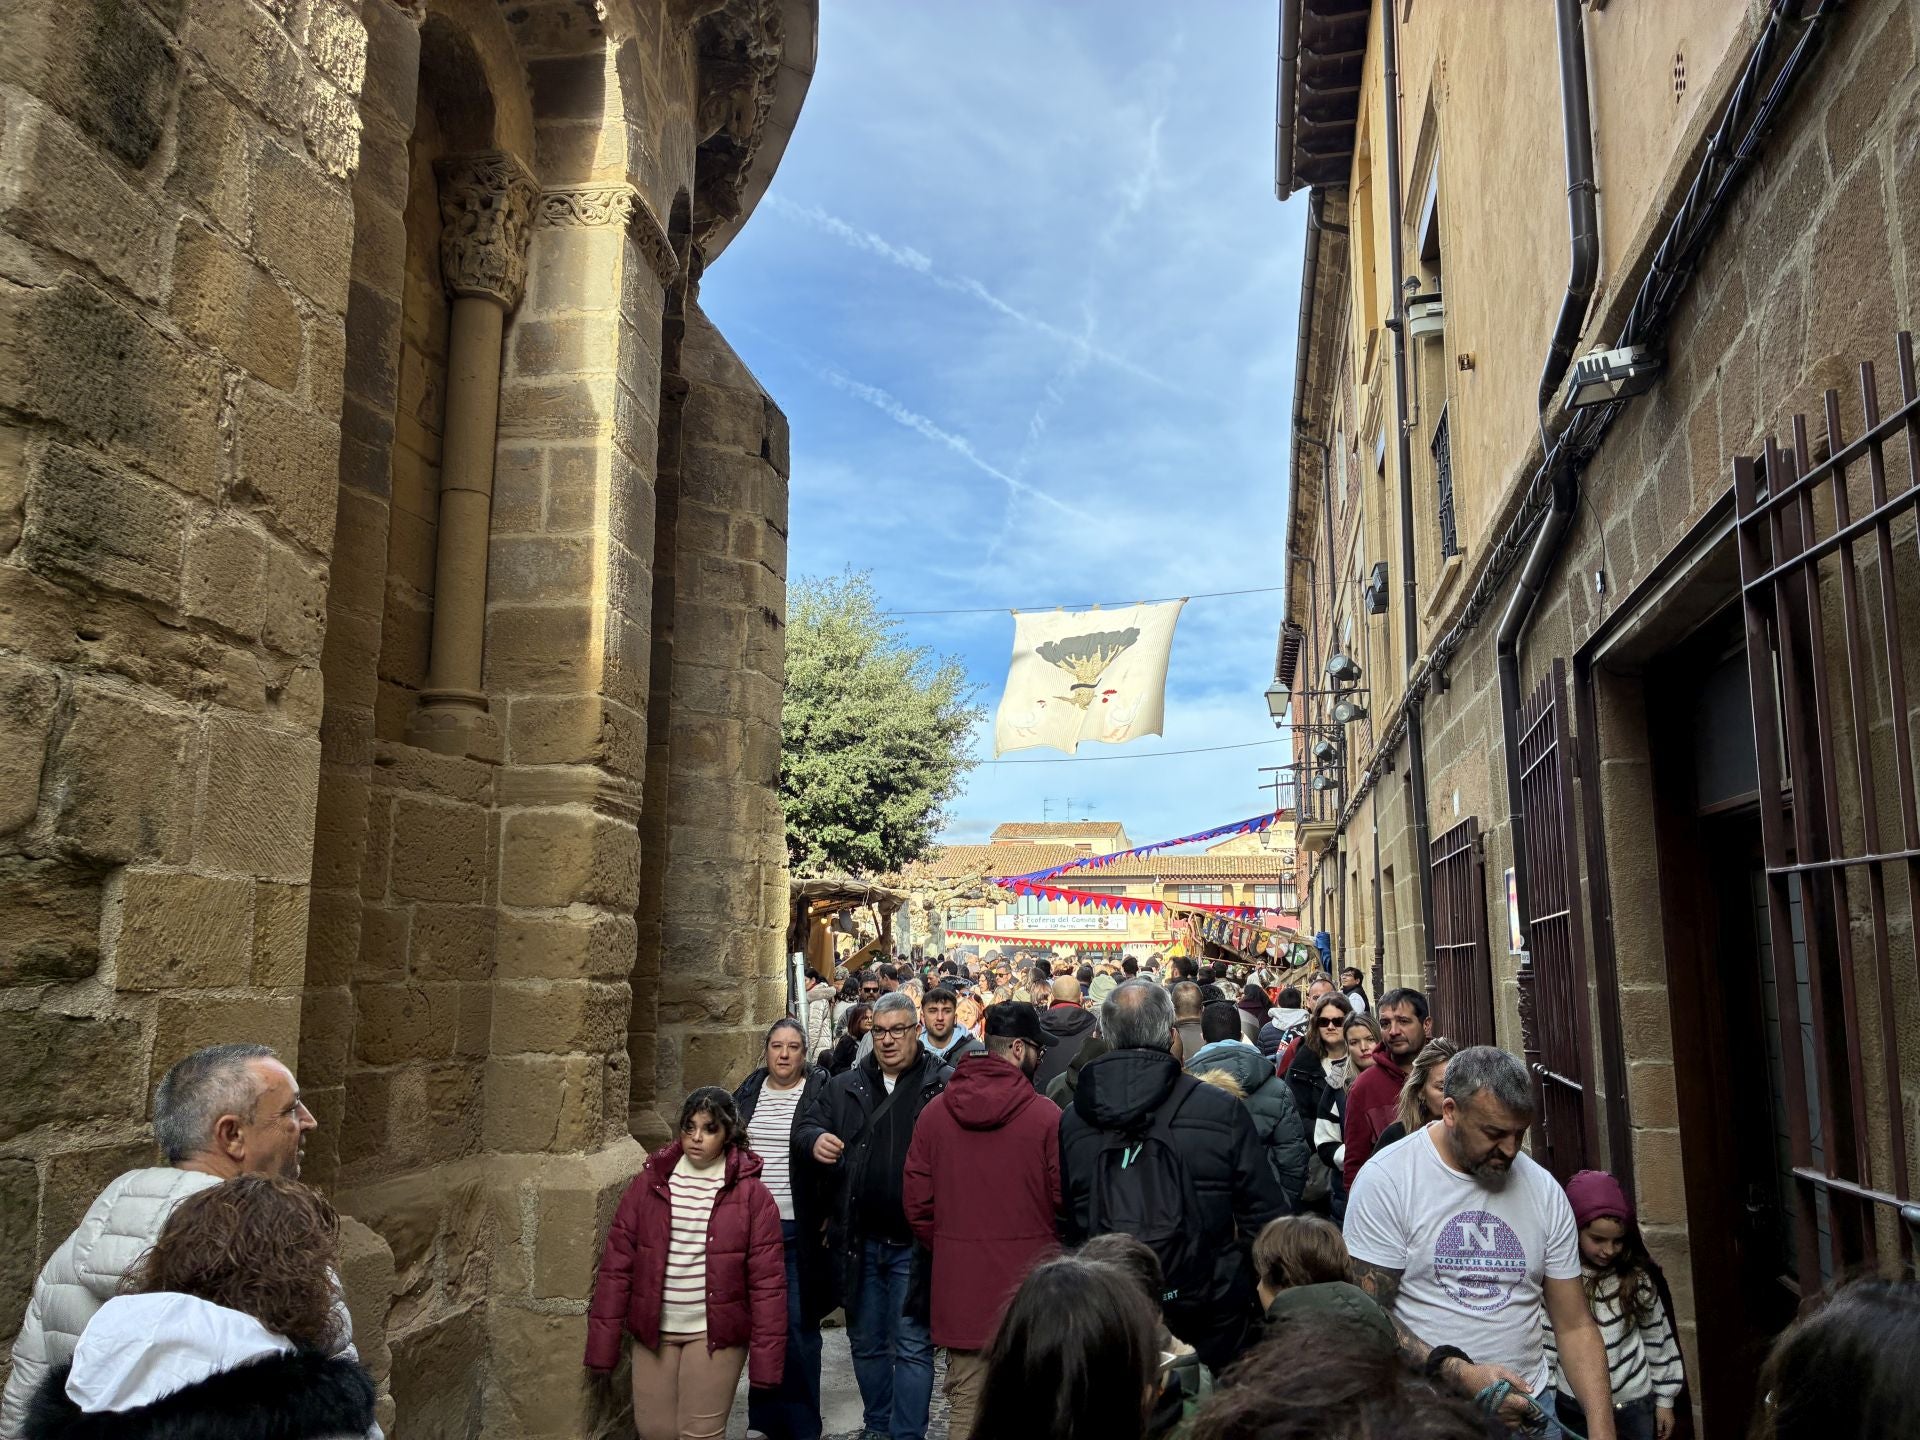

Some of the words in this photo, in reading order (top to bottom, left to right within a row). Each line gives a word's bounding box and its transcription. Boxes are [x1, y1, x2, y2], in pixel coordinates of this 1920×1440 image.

[1457, 1223, 1500, 1251] N
[1434, 1257, 1481, 1266] NORTH
[1485, 1259, 1526, 1267] SAILS
